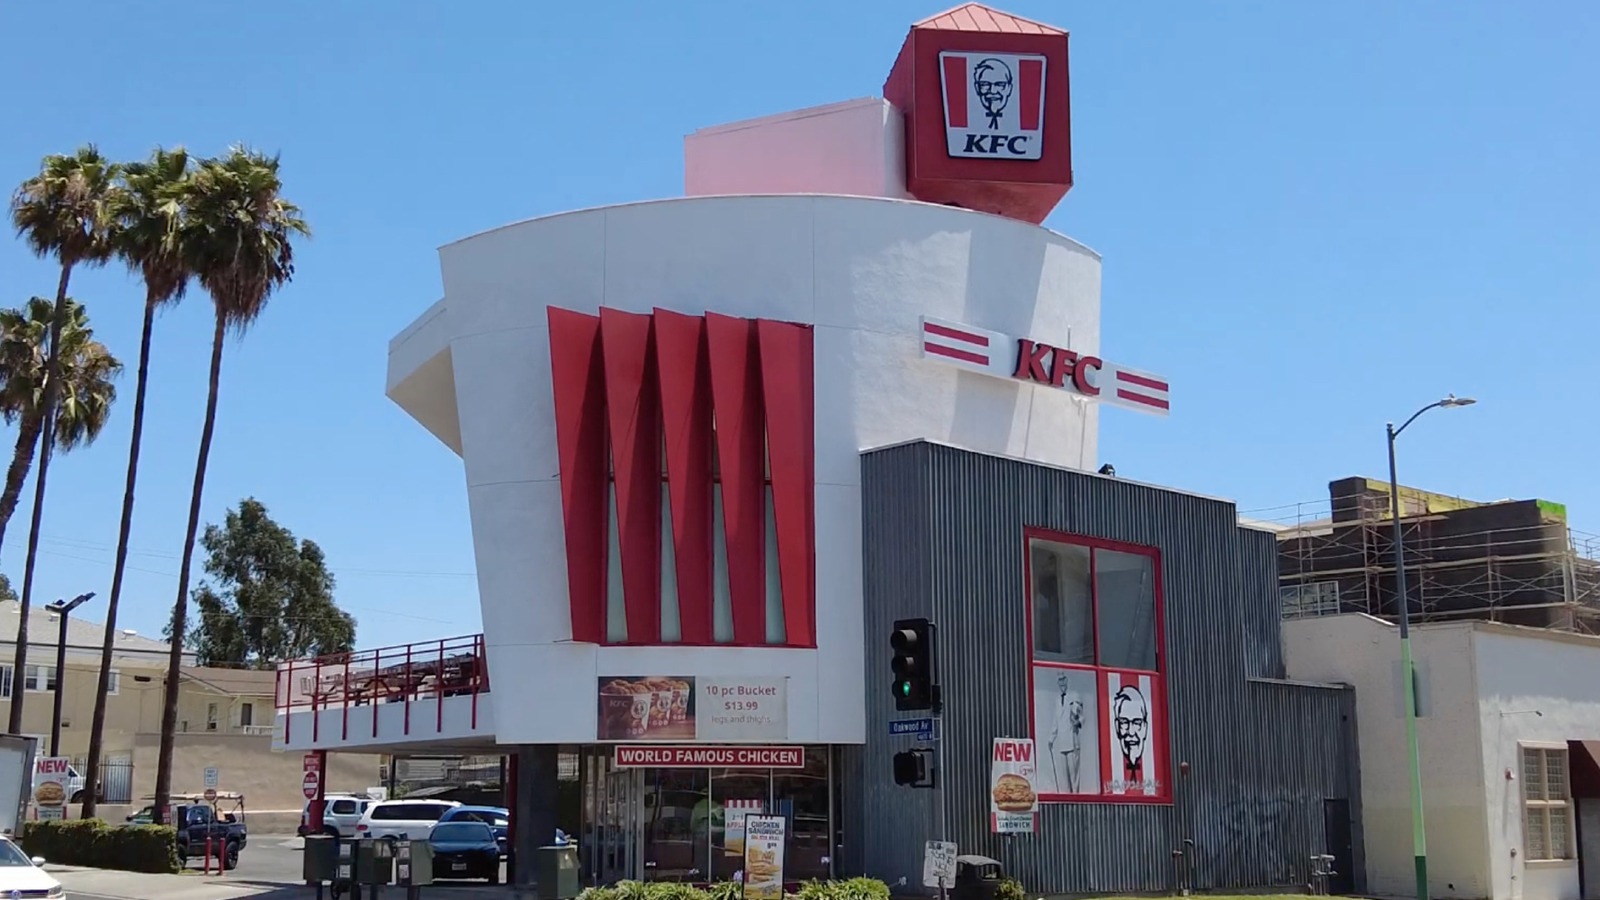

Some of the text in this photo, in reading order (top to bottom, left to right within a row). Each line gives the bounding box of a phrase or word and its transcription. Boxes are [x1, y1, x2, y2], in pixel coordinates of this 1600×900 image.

[963, 134, 1028, 154] KFC
[1012, 338, 1103, 396] KFC
[706, 685, 777, 701] 10 pc Bucket
[724, 701, 759, 711] $13.99
[711, 715, 771, 726] legs and thighs
[893, 721, 919, 732] Oakwood
[621, 750, 798, 763] WORLD FAMOUS CHICKEN
[994, 742, 1032, 762] NEW
[36, 760, 69, 774] NEW
[751, 821, 780, 829] CHICKEN
[999, 821, 1031, 829] SANDWICH
